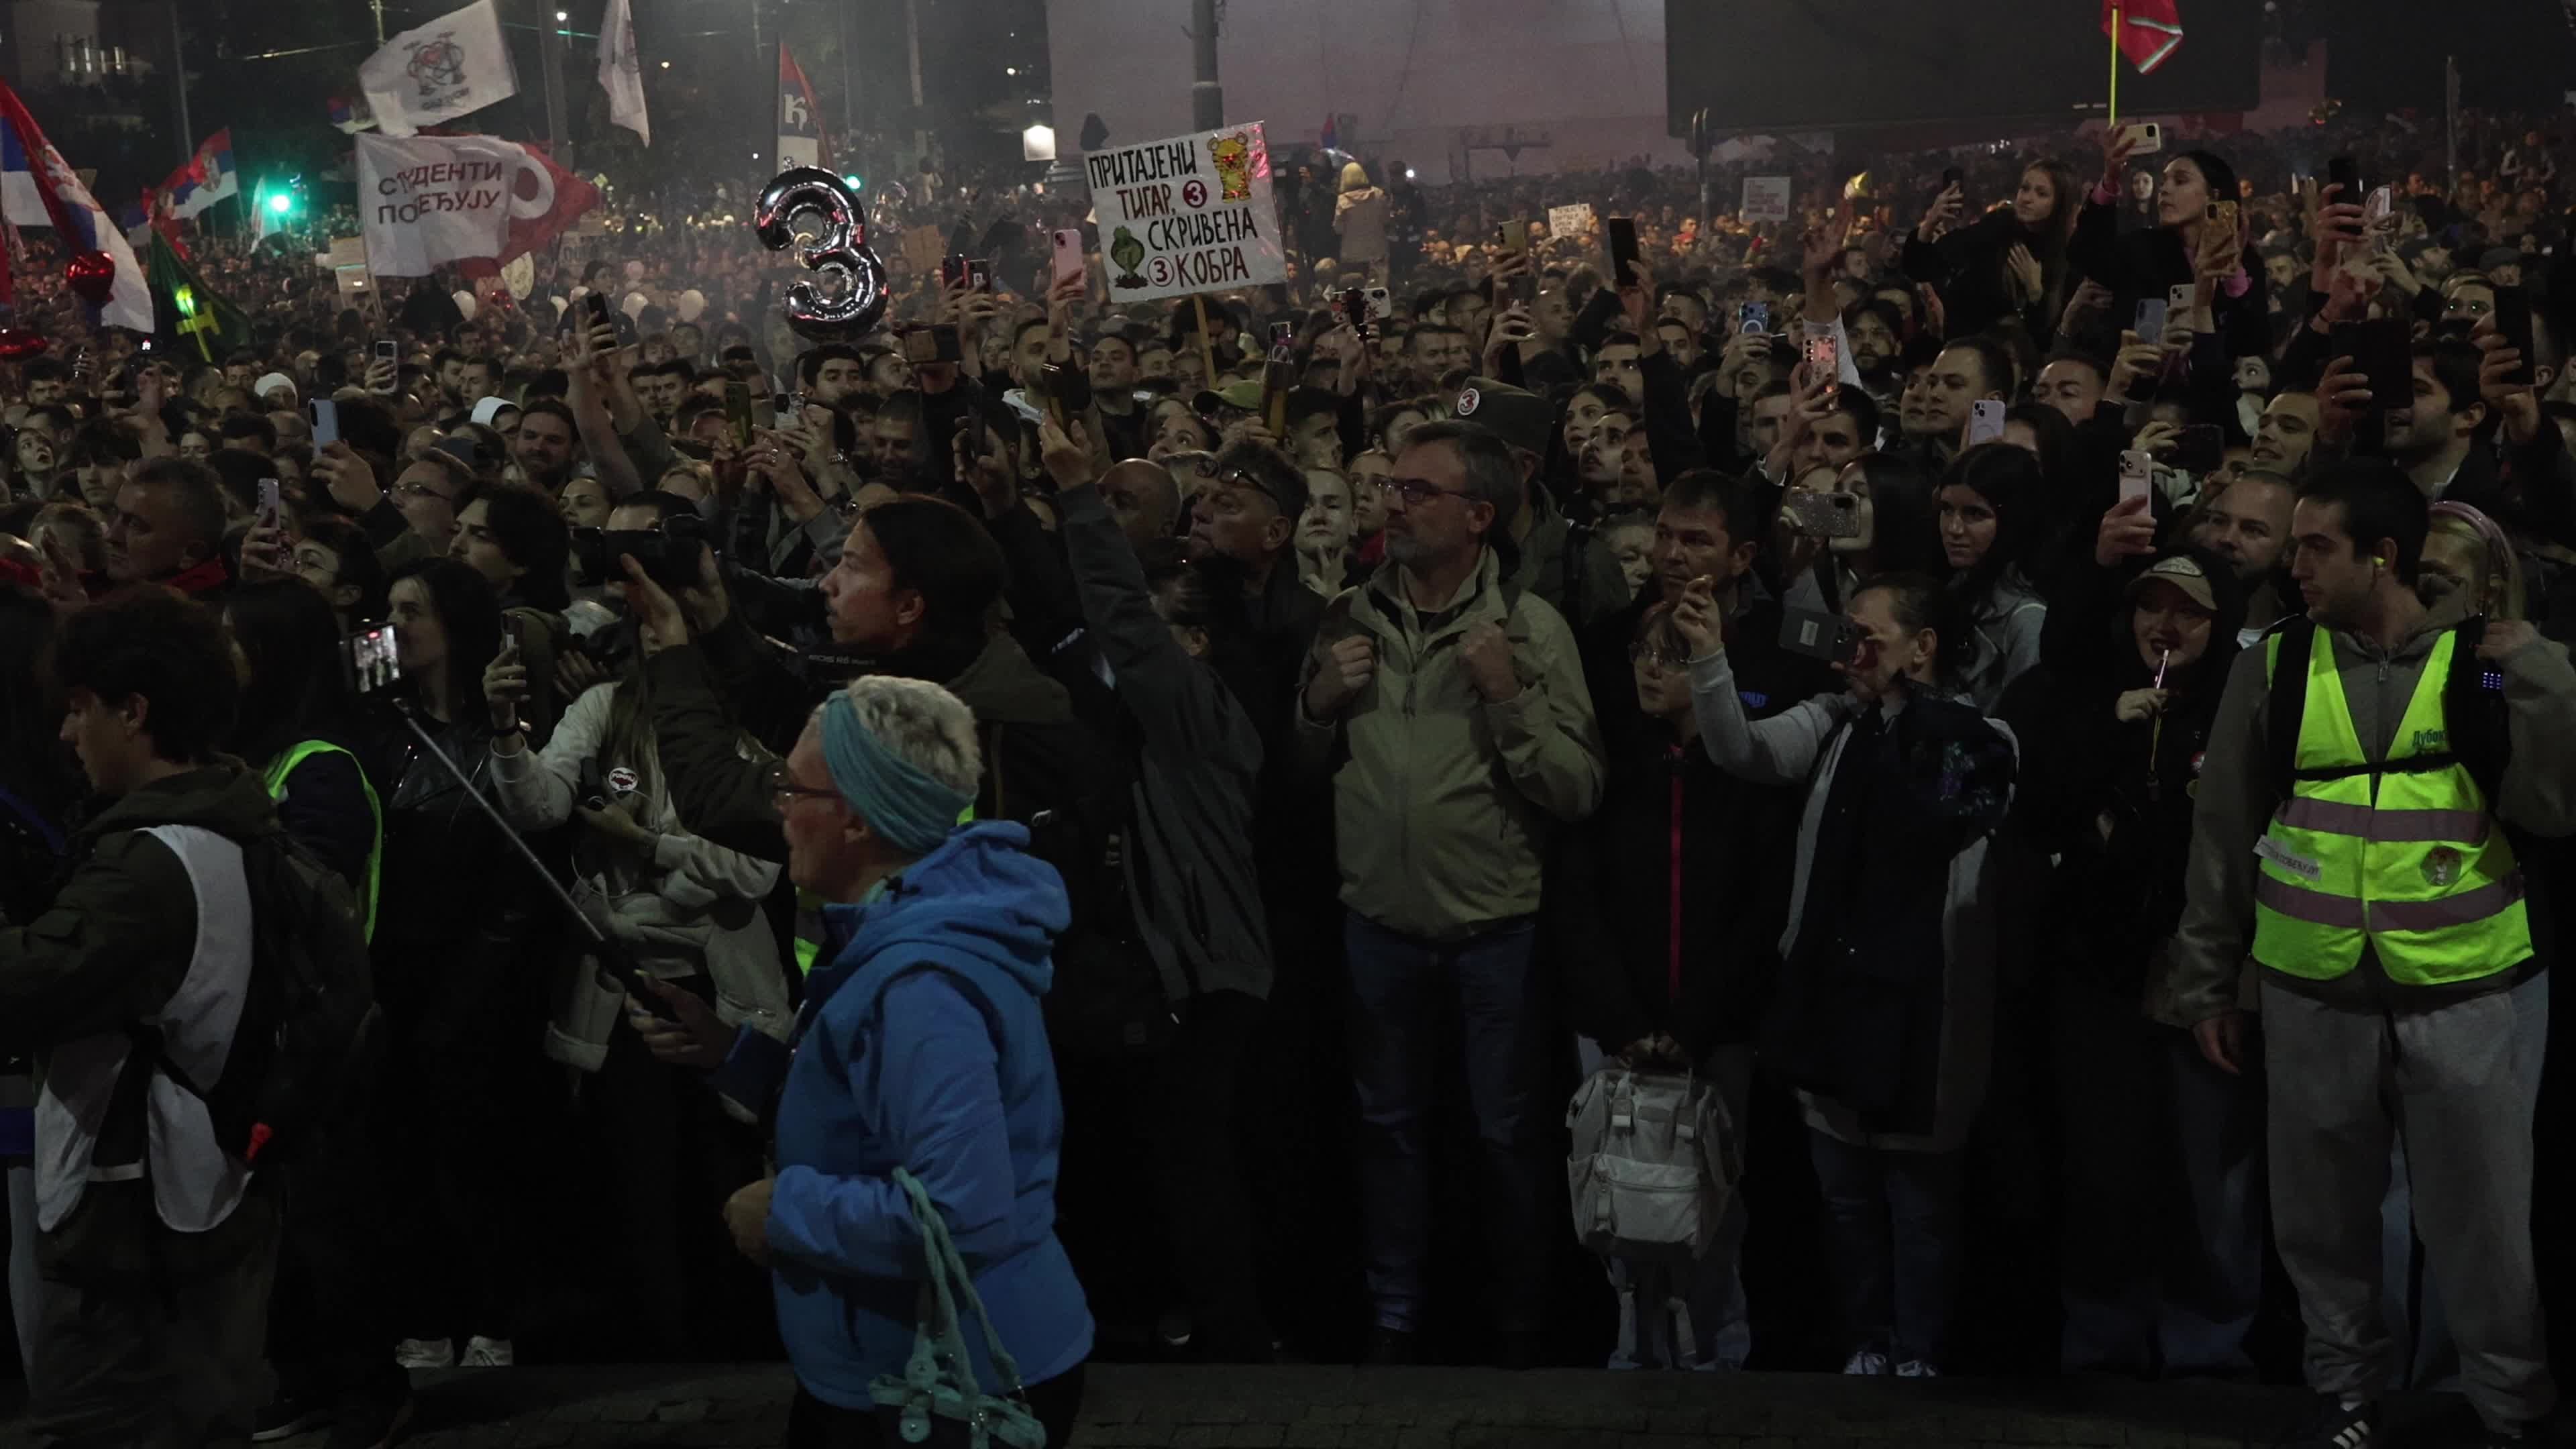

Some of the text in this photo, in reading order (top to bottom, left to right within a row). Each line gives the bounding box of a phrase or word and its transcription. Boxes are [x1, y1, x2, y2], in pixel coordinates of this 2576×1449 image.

[1089, 140, 1197, 189] ПРИТАЈЕНИ
[378, 190, 501, 224] ПОЕЂУЈУ
[1116, 182, 1203, 220] ТИГАР, 3
[1148, 207, 1258, 251] СКРИВЕНА
[753, 166, 890, 341] 3
[1154, 246, 1250, 287] 3 КОБРА
